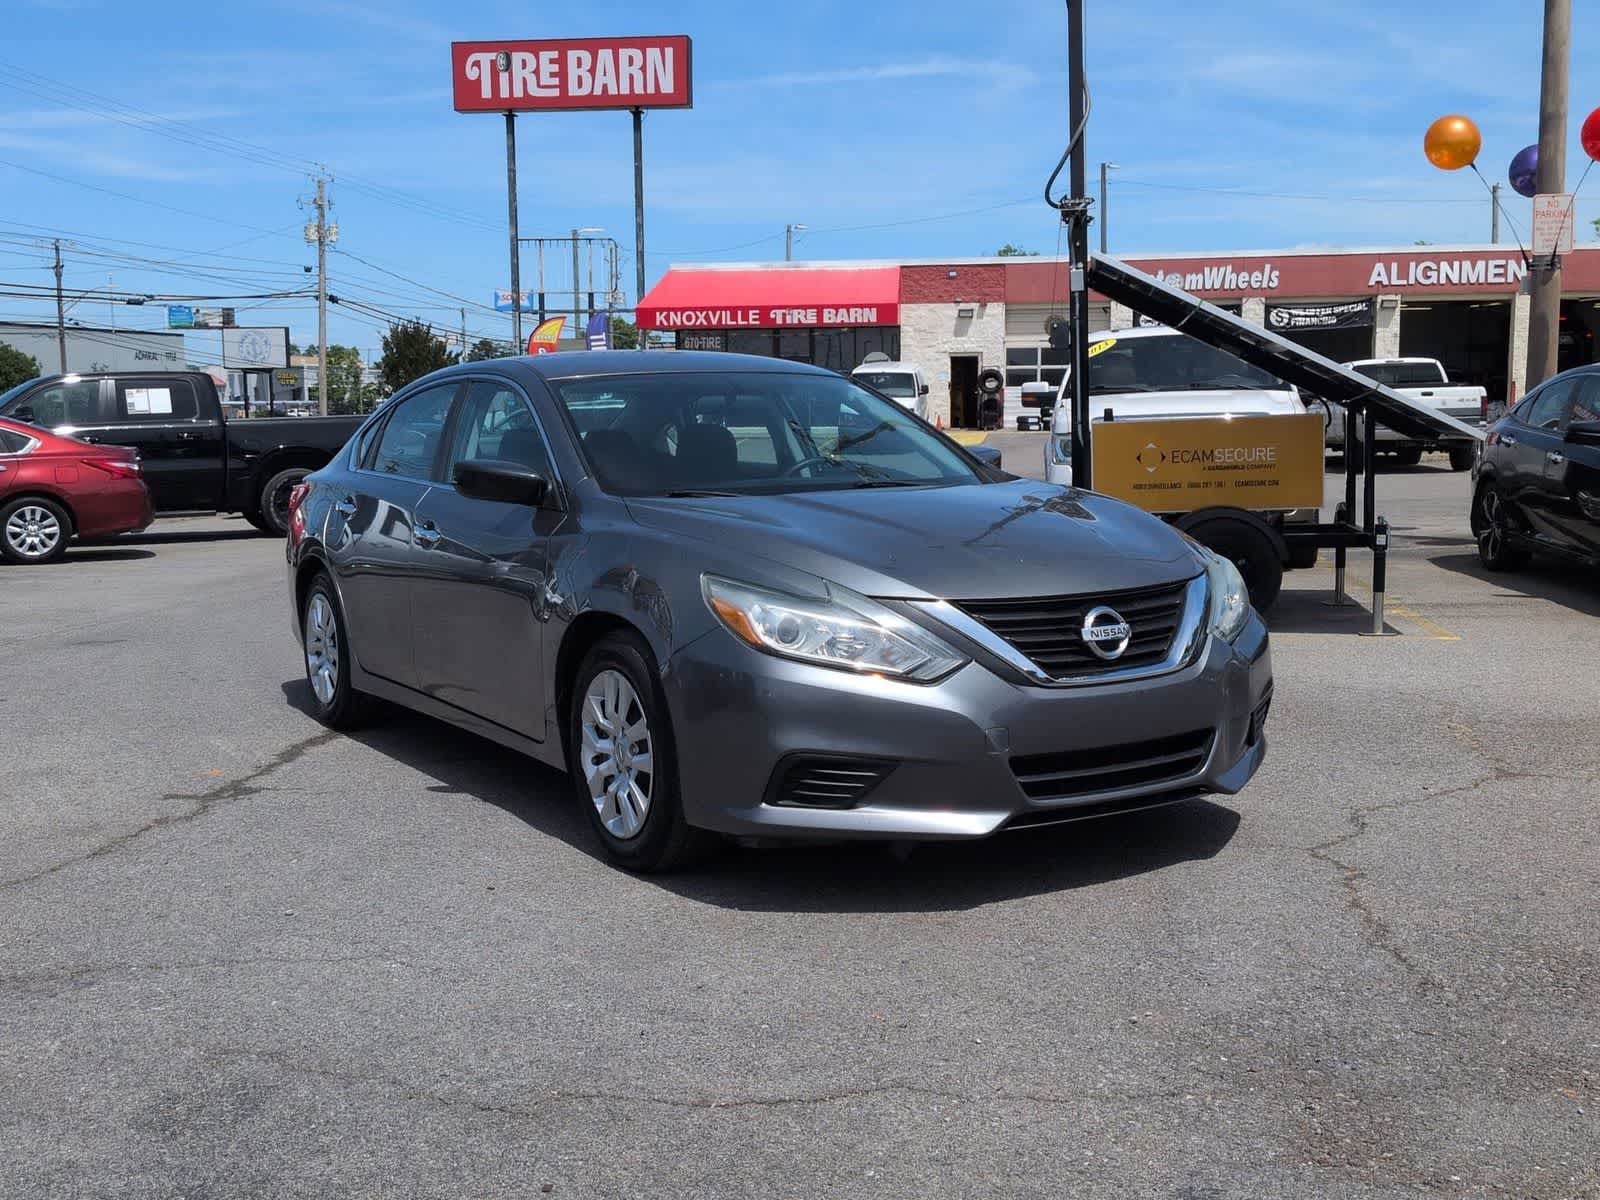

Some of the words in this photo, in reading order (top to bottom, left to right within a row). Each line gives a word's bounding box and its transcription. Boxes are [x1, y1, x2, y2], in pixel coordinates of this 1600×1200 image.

[567, 47, 674, 96] BARN
[1546, 199, 1559, 209] NO
[1535, 210, 1571, 219] PARKING
[1368, 259, 1527, 286] ALIGNMEN
[1333, 302, 1368, 313] SPECIAL
[655, 309, 761, 327] KNOXVILLE
[823, 307, 877, 324] BARN
[1170, 448, 1277, 464] ECAMSECURE
[1090, 625, 1130, 639] NISSAN
